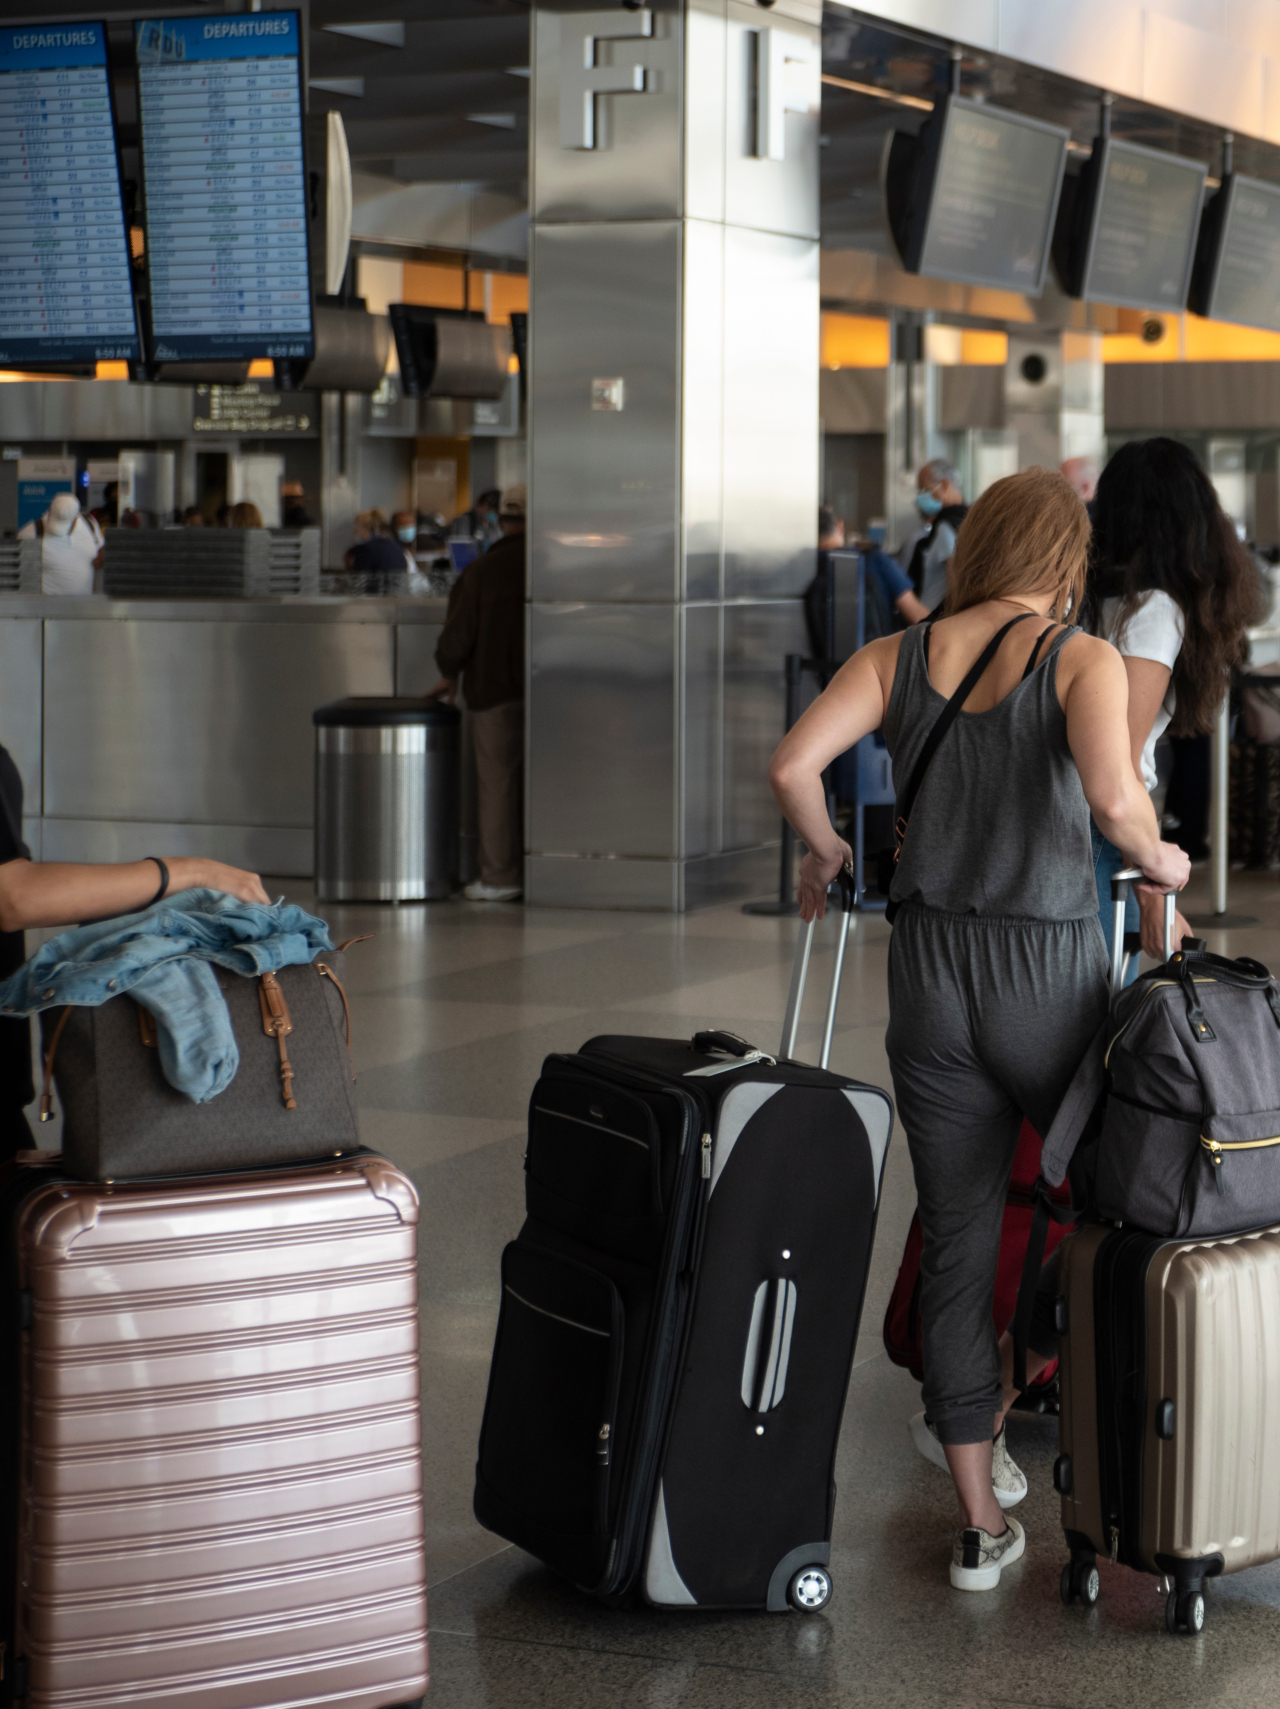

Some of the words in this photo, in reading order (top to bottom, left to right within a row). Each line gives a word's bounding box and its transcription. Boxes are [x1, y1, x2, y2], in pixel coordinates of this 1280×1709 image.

[204, 18, 290, 39] DEPARTURES
[13, 31, 96, 50] DEPARTURES
[560, 8, 652, 149] F
[95, 347, 115, 359] 8:50
[116, 347, 132, 359] AM
[266, 344, 288, 357] 8:50
[288, 344, 305, 356] AM
